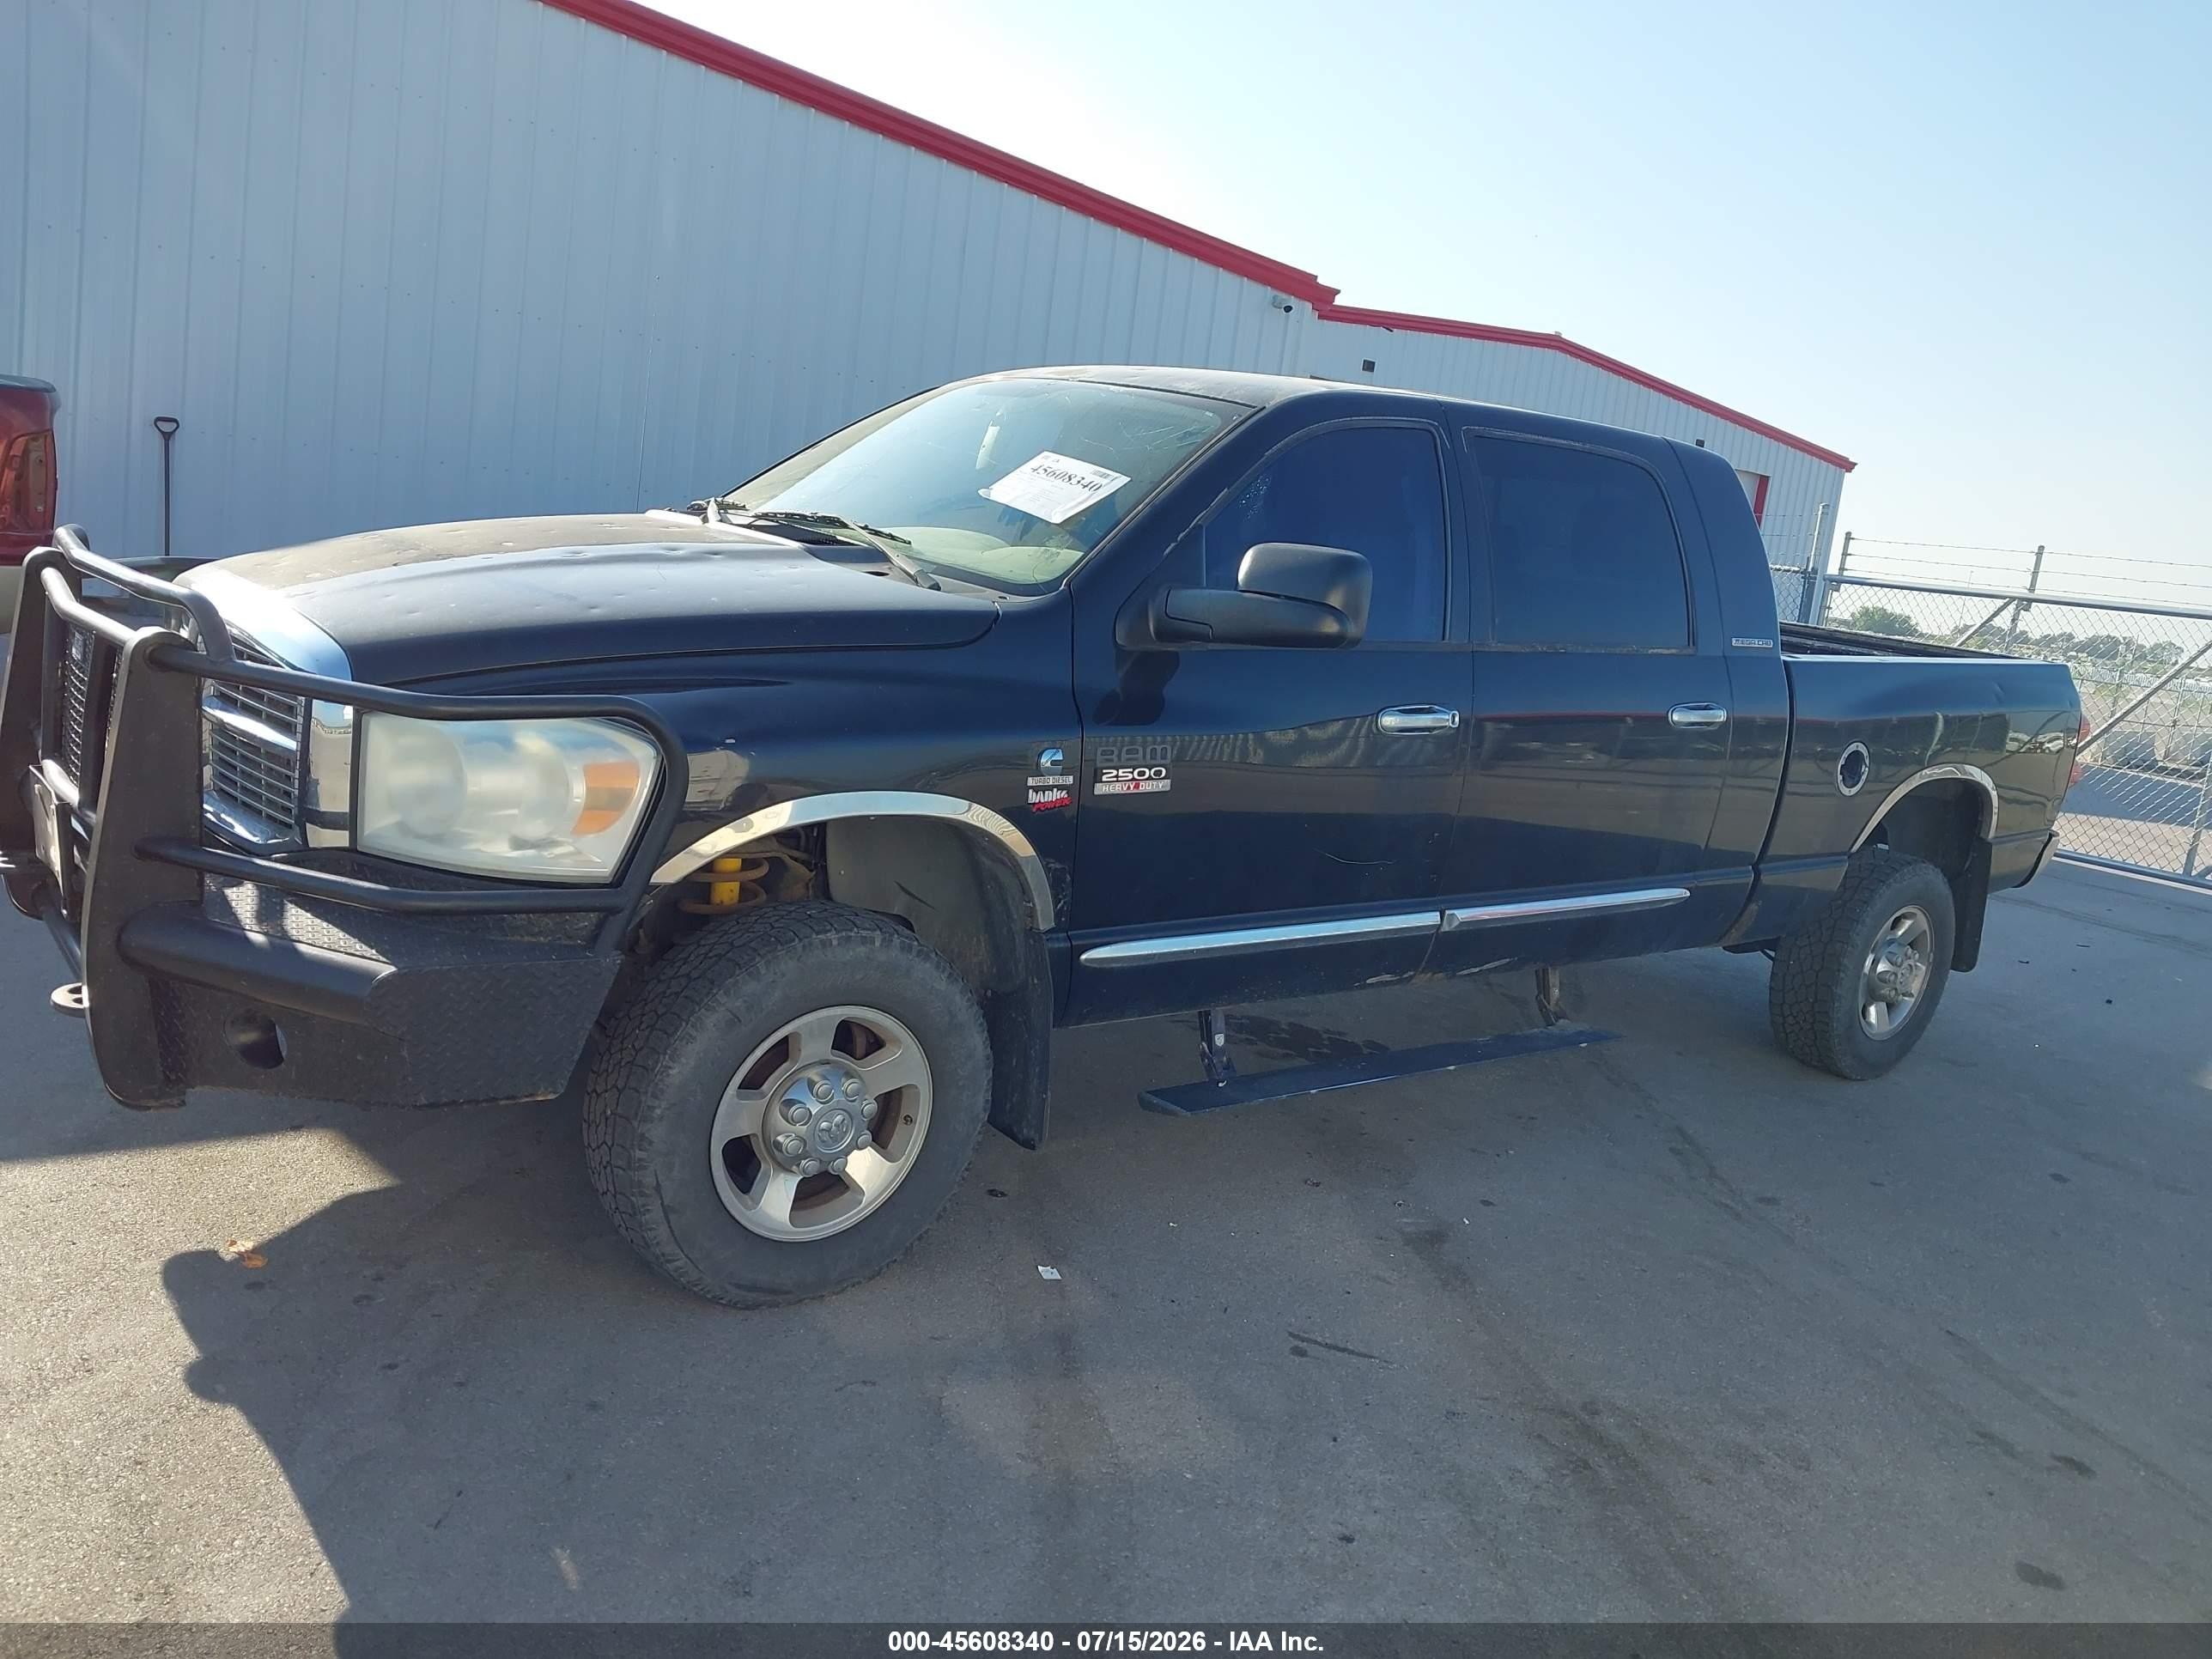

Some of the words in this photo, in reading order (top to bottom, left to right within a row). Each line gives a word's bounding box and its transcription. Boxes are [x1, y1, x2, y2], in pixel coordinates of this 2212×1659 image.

[1030, 464, 1104, 492] 45608340
[1102, 767, 1166, 781] 2500
[1102, 782, 1134, 792] HEAVY
[1139, 781, 1164, 790] DUTY
